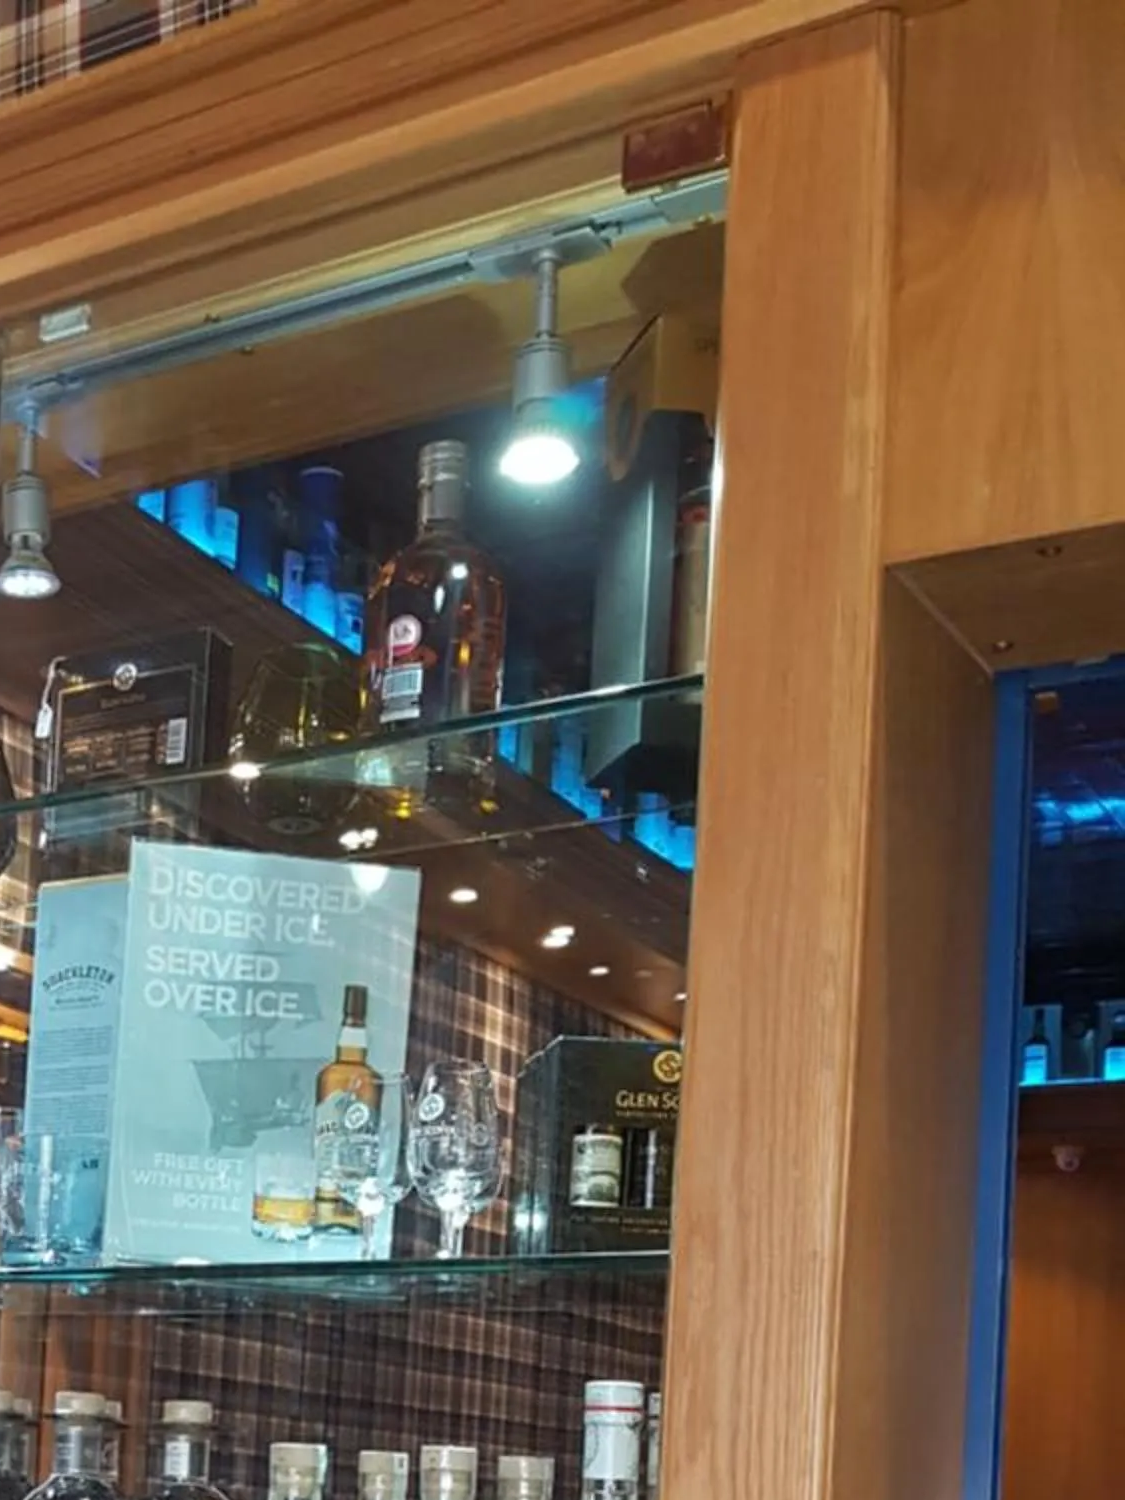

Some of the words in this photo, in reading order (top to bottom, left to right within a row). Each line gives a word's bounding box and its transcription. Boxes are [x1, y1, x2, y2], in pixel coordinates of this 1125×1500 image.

[149, 866, 366, 914] DISCOVERED
[148, 898, 266, 941] UNDER
[145, 945, 280, 982] SERVED
[144, 978, 237, 1015] OVER
[615, 1089, 659, 1108] GLEN
[154, 1152, 200, 1171] FREE
[132, 1168, 181, 1188] WITH
[172, 1192, 243, 1212] BOTTLE
